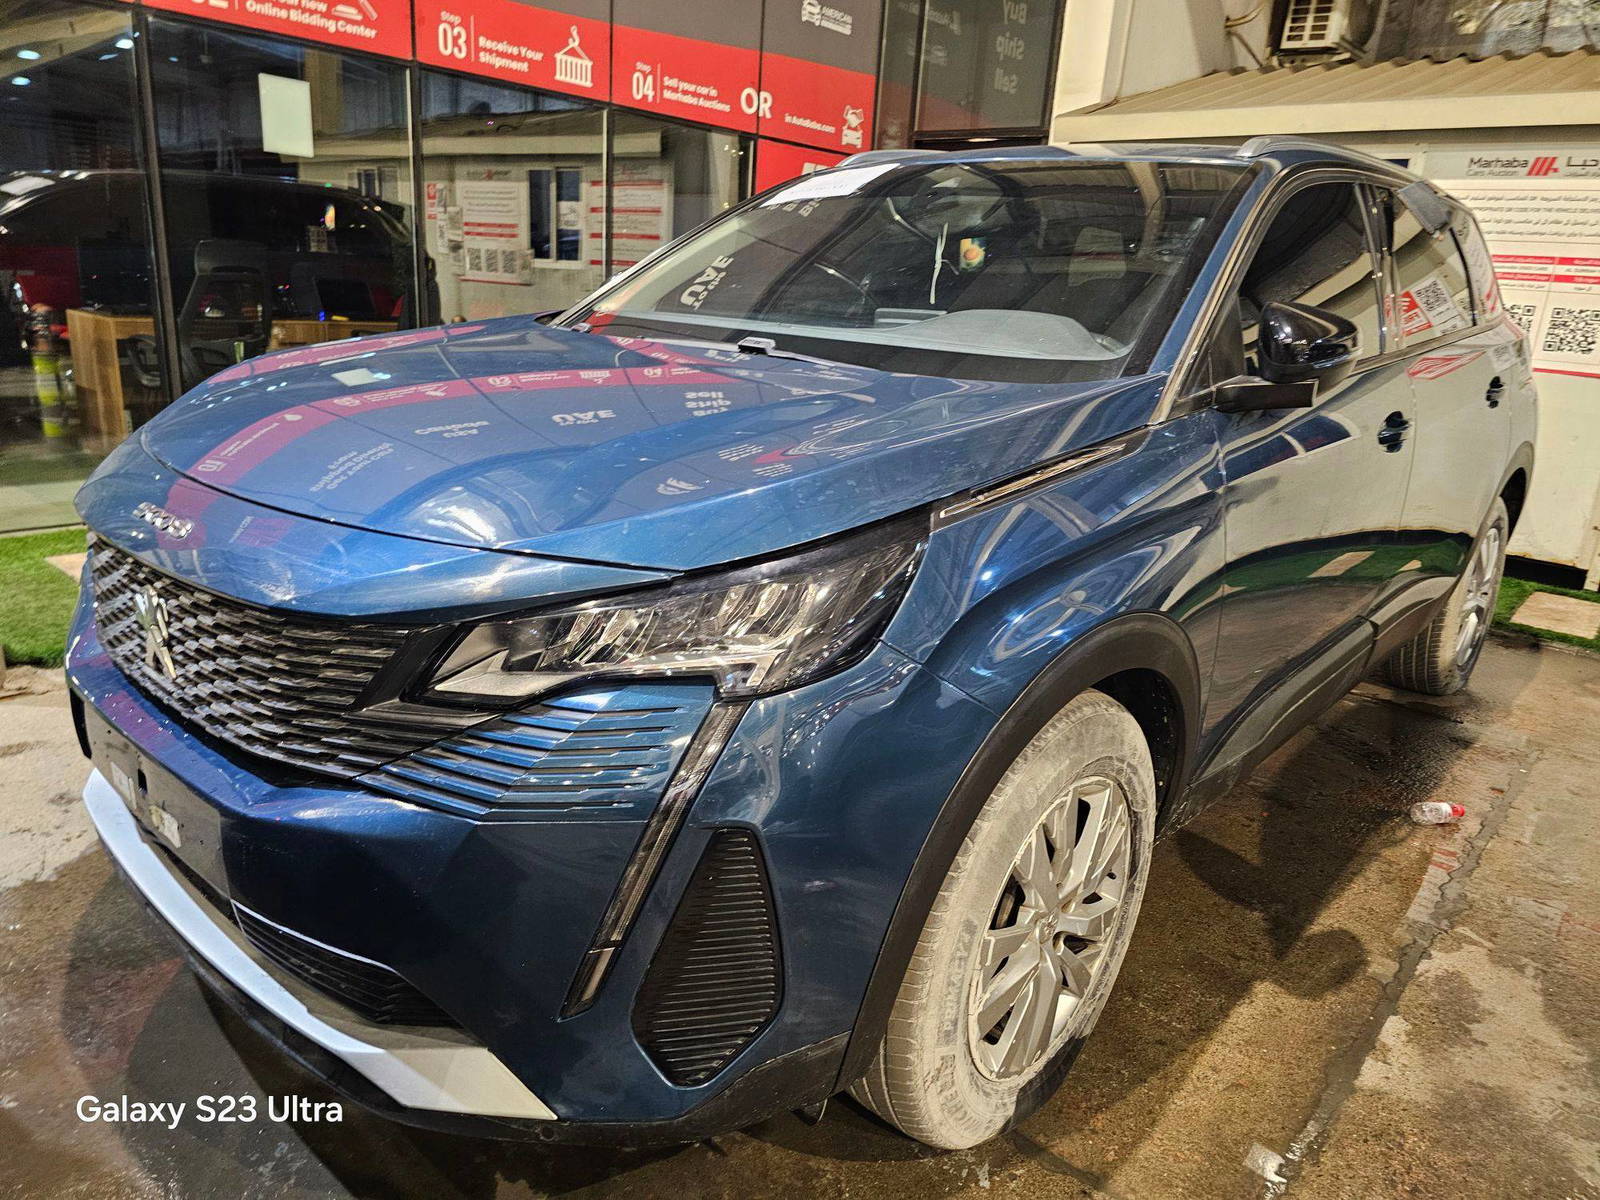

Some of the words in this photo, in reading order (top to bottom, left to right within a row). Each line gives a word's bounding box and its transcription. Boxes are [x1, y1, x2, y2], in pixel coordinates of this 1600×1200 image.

[246, 0, 289, 19] Online
[289, 9, 337, 34] Bidding
[336, 18, 377, 39] Center
[440, 10, 462, 26] Step
[438, 22, 467, 59] 03
[479, 35, 519, 56] Receive
[520, 46, 544, 61] Your
[479, 51, 529, 72] Shipment
[632, 71, 655, 102] 04
[740, 87, 773, 119] OR
[1467, 156, 1529, 169] Marhaba
